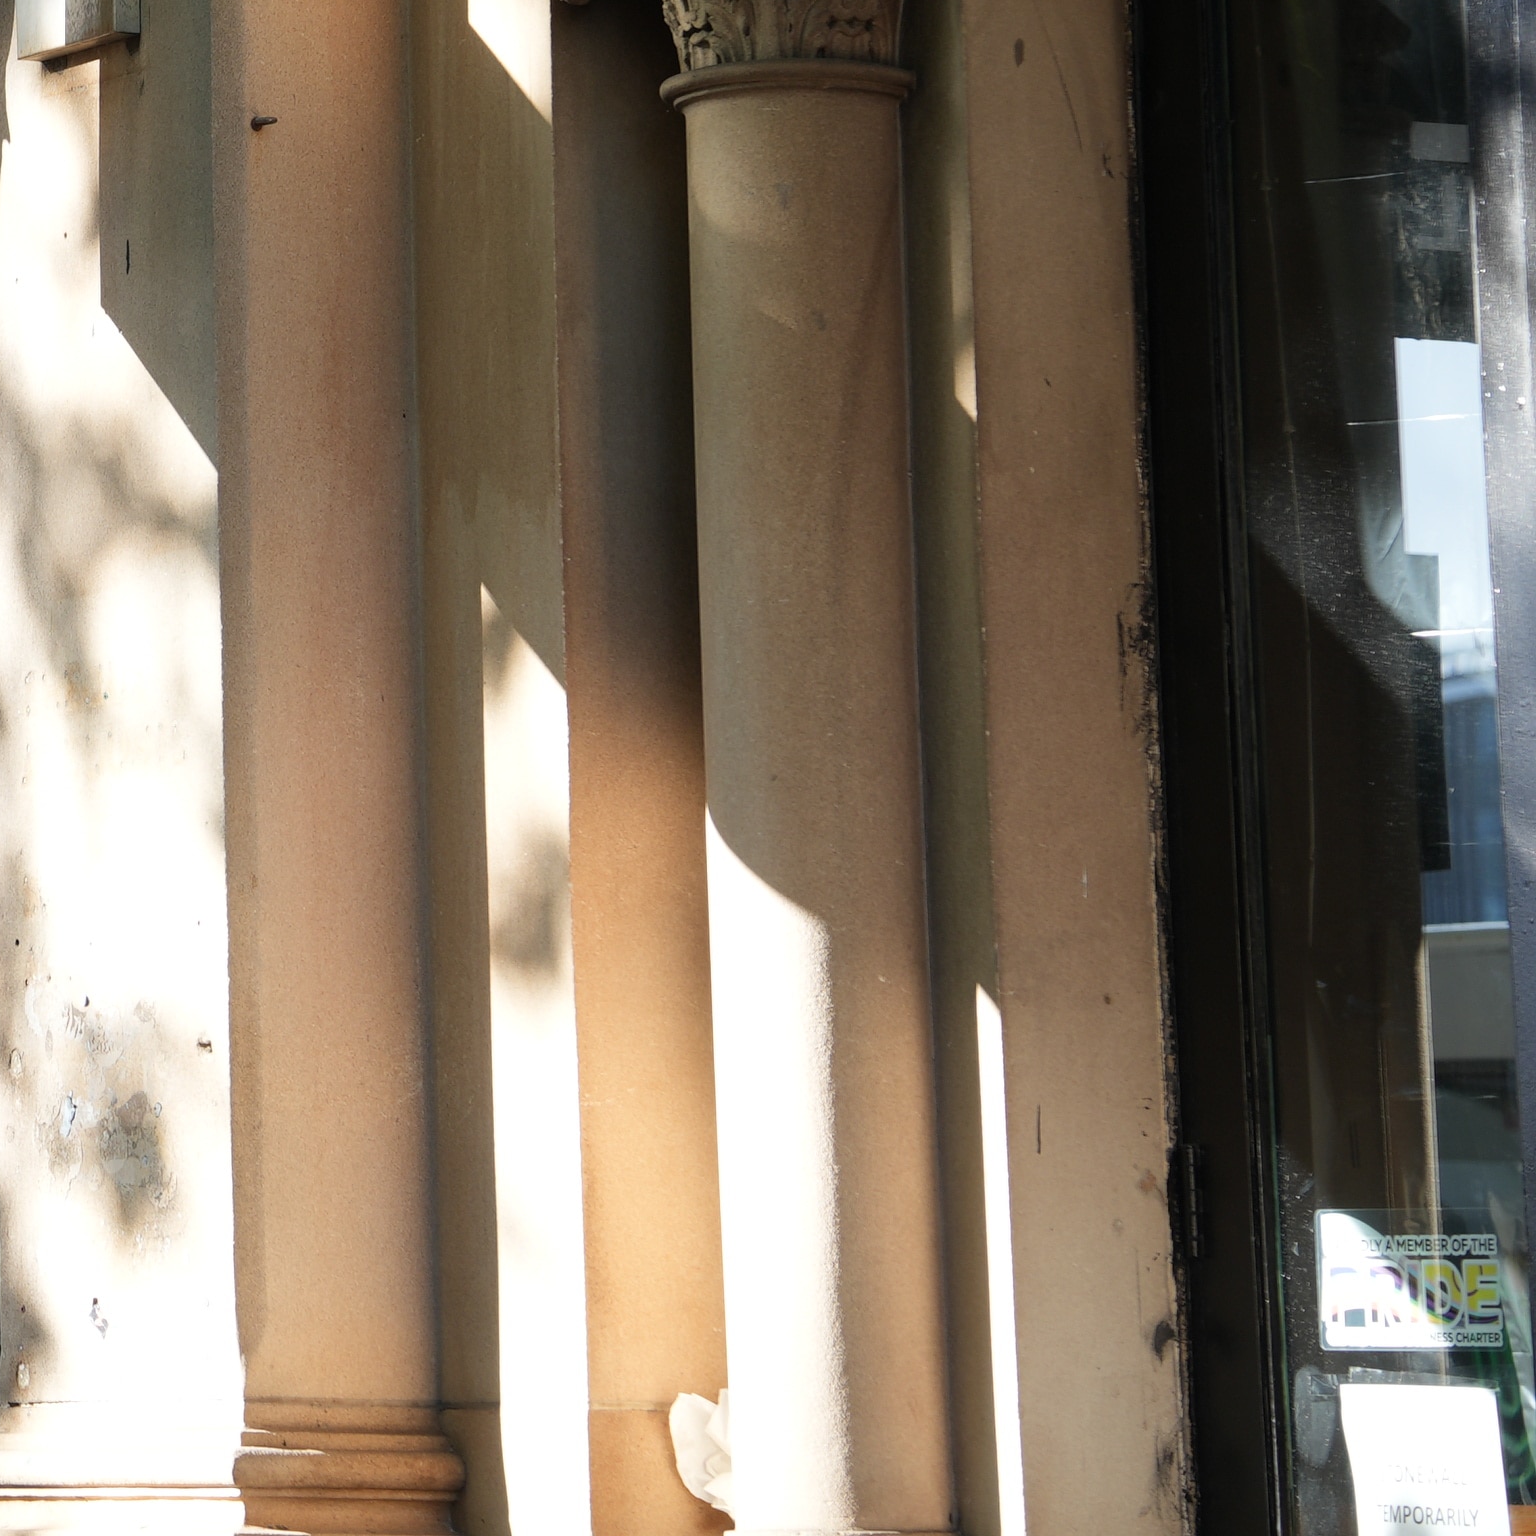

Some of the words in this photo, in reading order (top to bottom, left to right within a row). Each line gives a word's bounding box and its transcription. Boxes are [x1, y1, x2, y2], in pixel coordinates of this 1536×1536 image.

[1385, 1238, 1394, 1252] A
[1397, 1238, 1449, 1252] MEMBER
[1452, 1238, 1469, 1252] OF
[1471, 1238, 1496, 1252] THE
[1328, 1262, 1501, 1326] PRIDE
[1455, 1332, 1502, 1344] CHARTER
